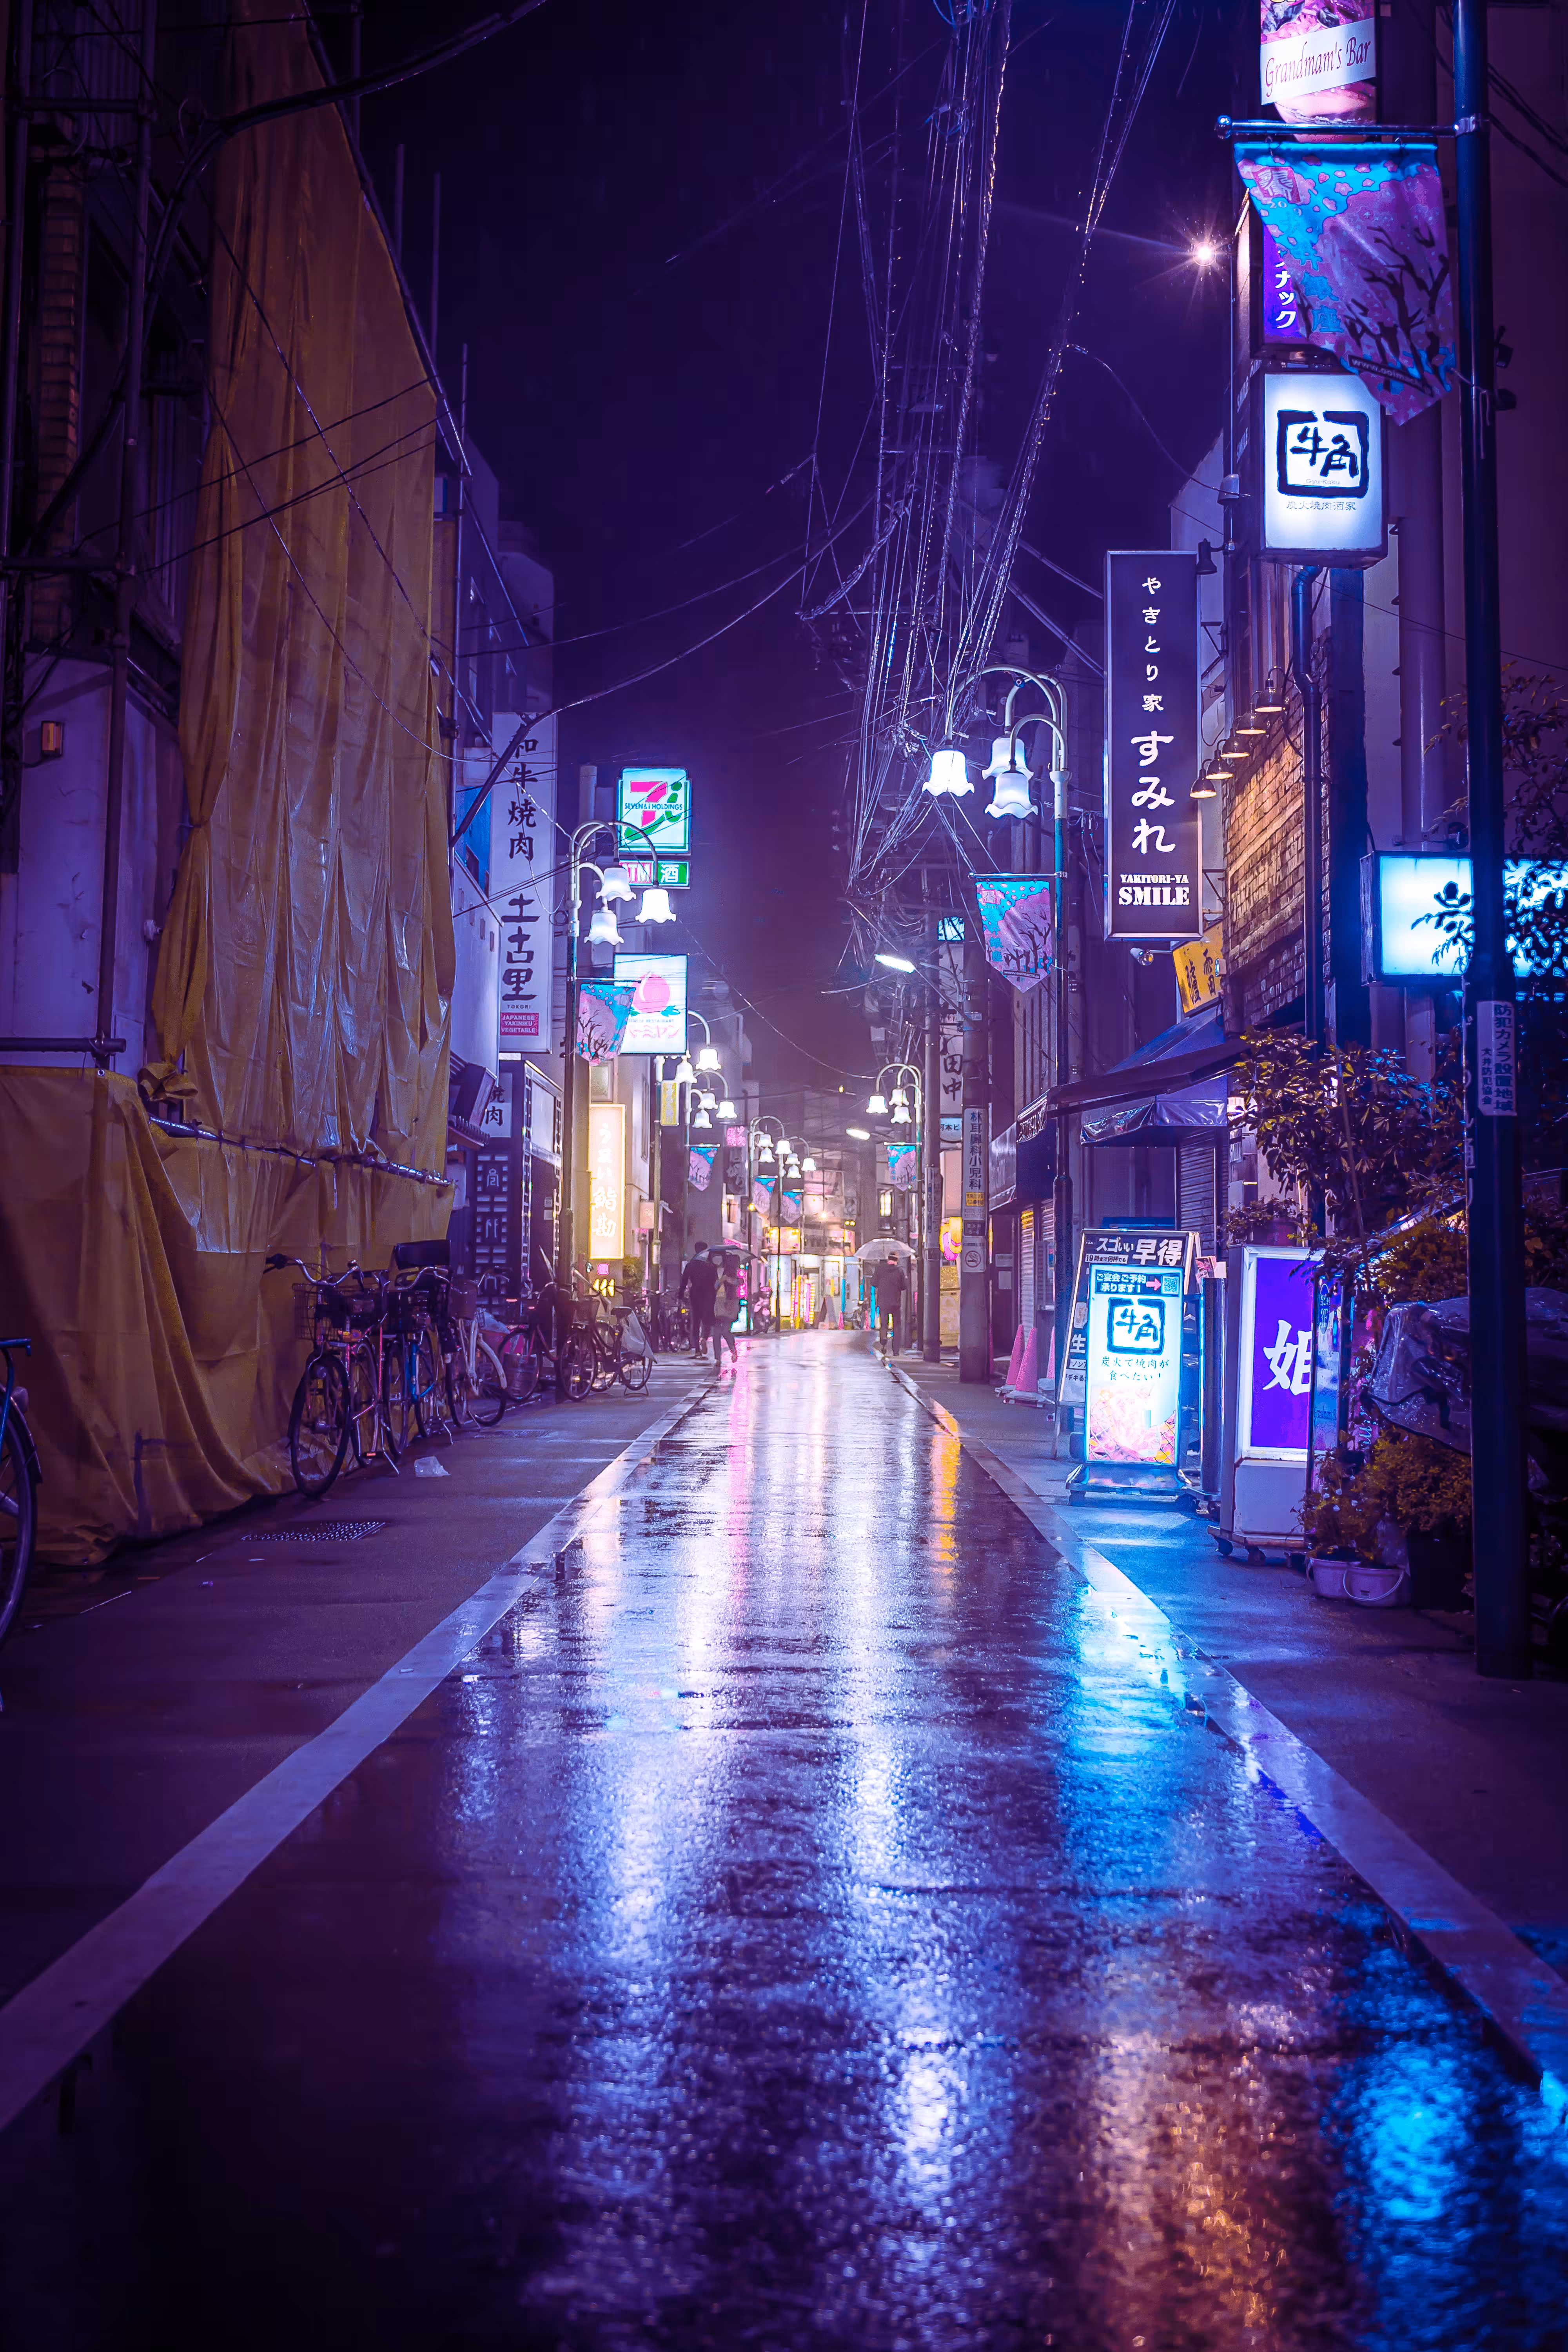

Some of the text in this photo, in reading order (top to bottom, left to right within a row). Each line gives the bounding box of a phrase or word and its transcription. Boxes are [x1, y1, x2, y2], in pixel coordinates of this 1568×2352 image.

[1265, 36, 1371, 97] Grandmam's Bar
[1275, 261, 1296, 329] ナック
[1290, 426, 1359, 478] 牛角
[1286, 501, 1356, 511] 炭火焼肉酒家
[1130, 577, 1176, 855] やきとり家 すみれ
[507, 725, 539, 860] 和牛焼肉
[660, 864, 680, 883] 酒
[1120, 874, 1189, 884] YAKITORI-YA
[1118, 886, 1190, 906] SMILE
[501, 893, 540, 1001] 土古里
[1096, 1273, 1147, 1283] ご宴会ご予約
[1115, 1308, 1158, 1342] 牛角
[1070, 1334, 1086, 1354] 生
[1101, 1356, 1169, 1369] 炭火で焼肉が
